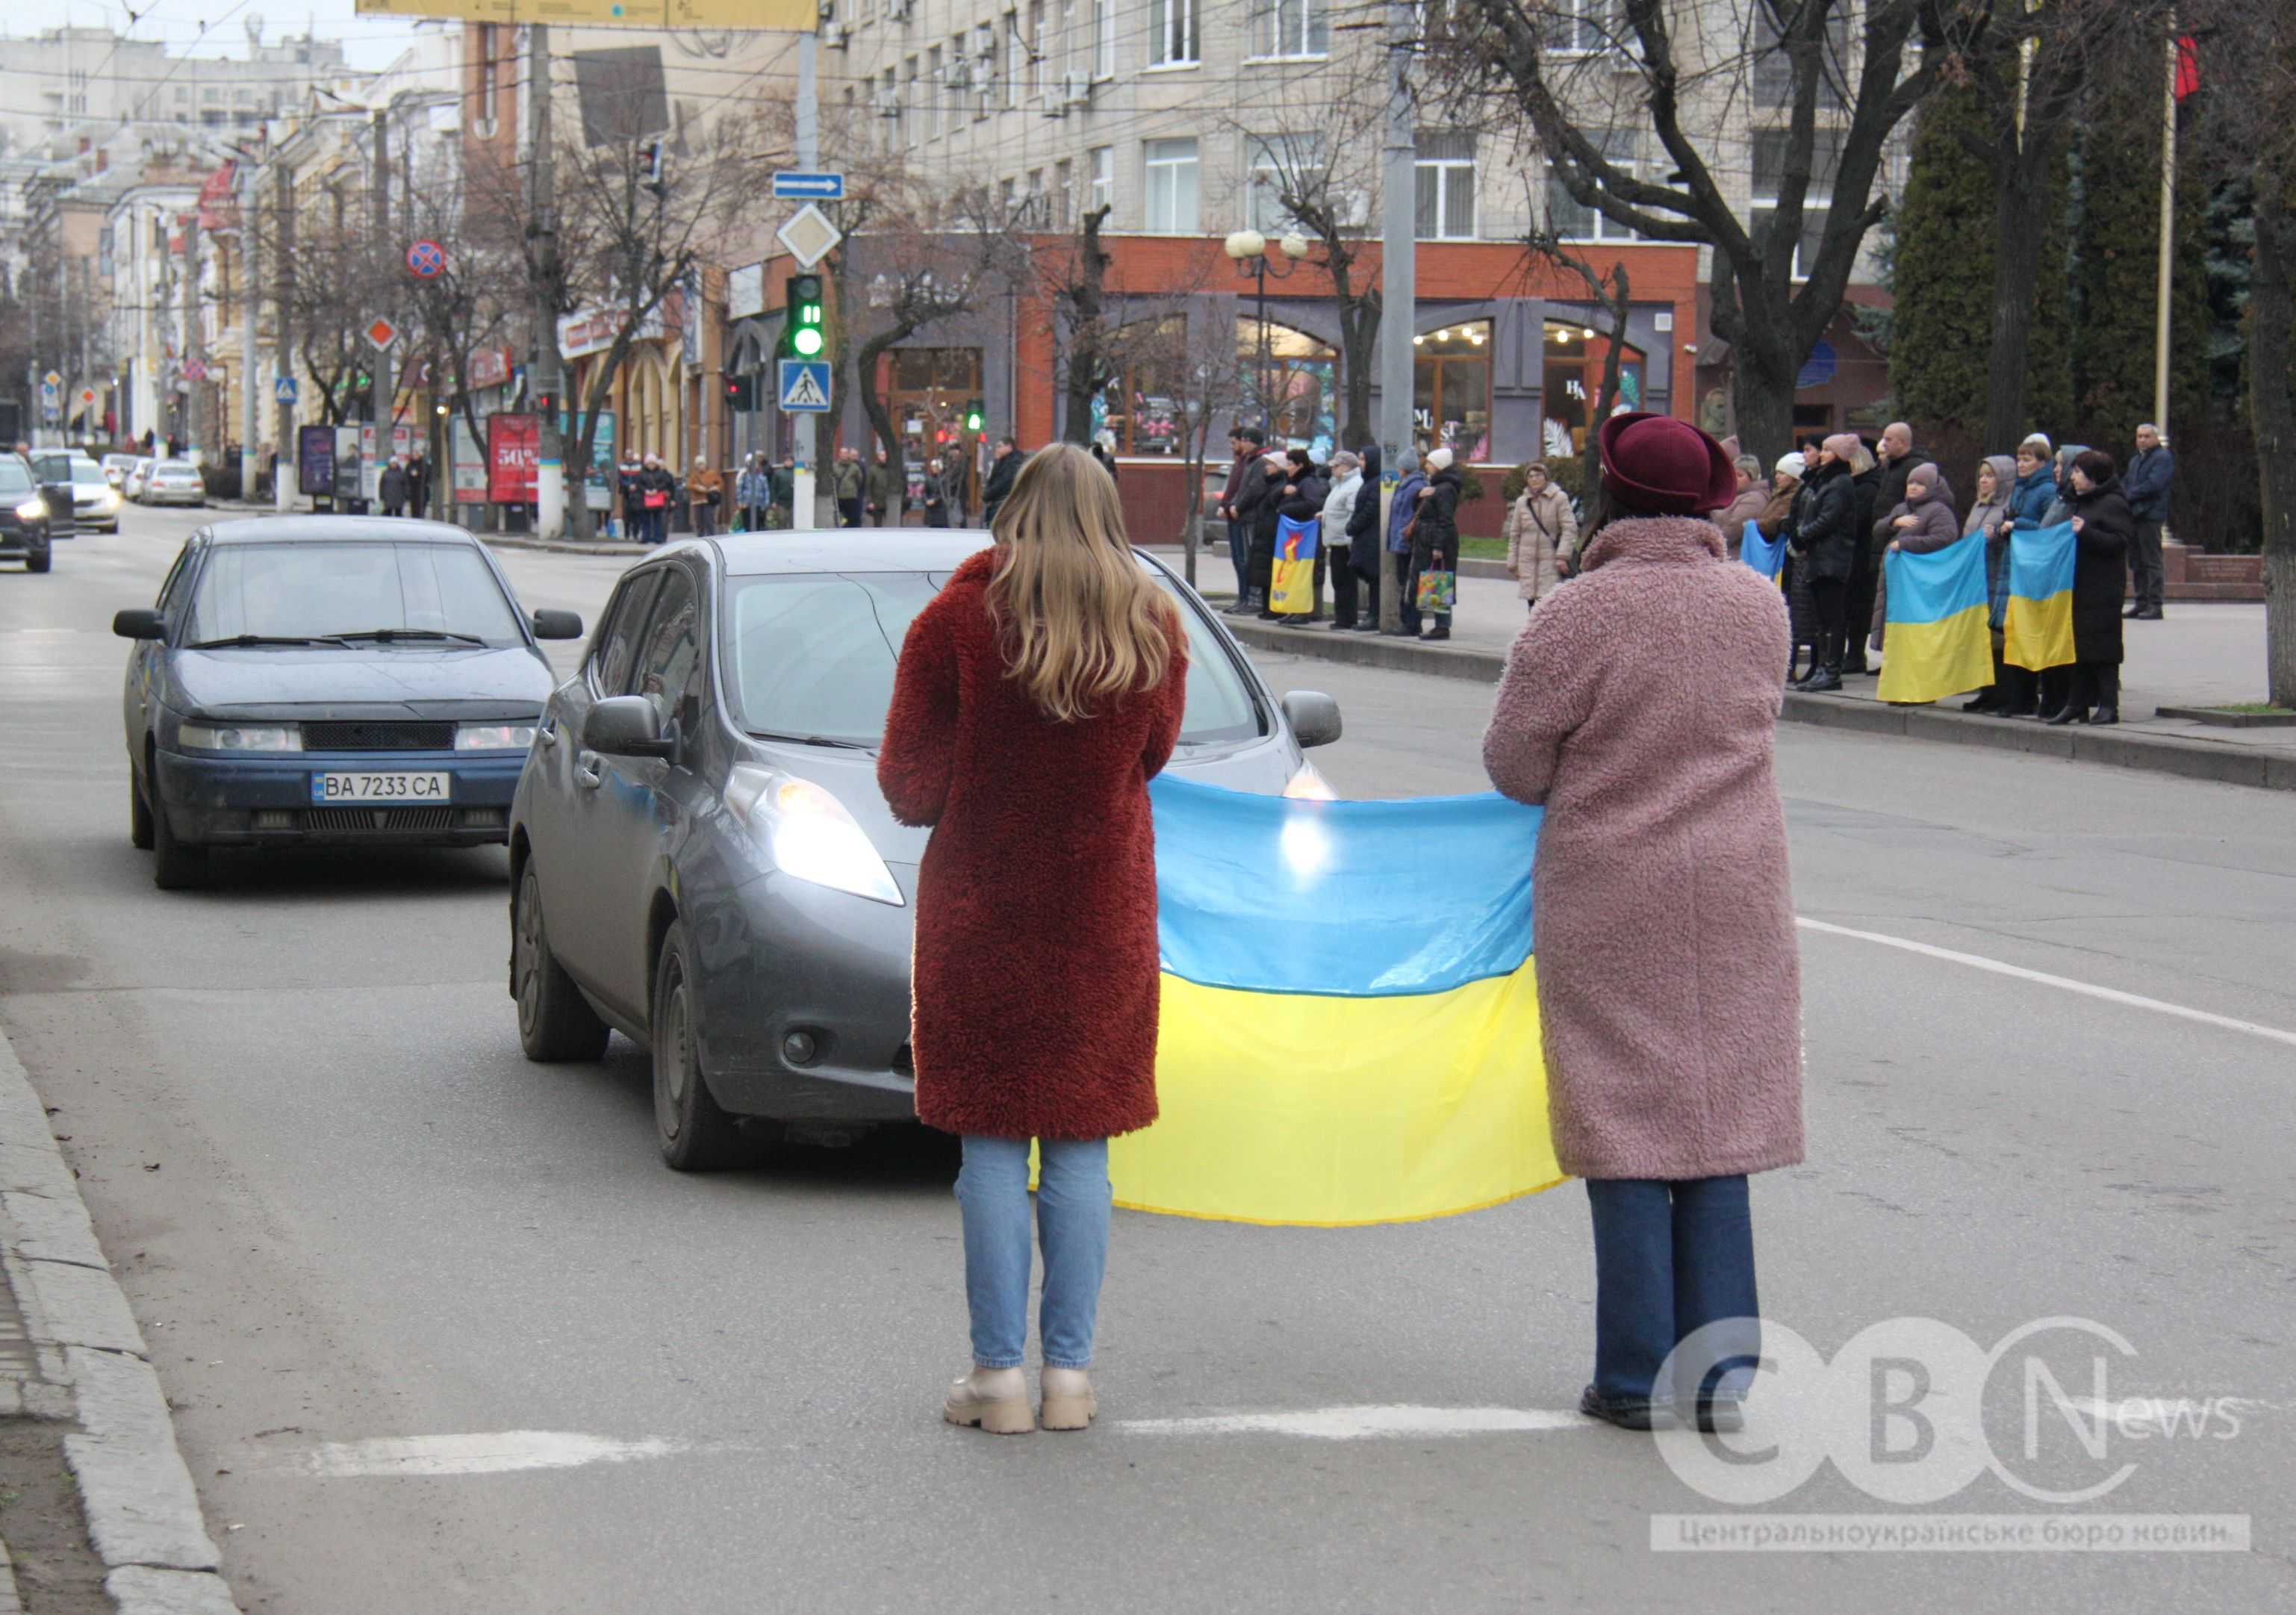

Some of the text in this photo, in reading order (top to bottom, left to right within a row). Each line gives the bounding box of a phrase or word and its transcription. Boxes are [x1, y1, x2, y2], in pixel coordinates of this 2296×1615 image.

[326, 776, 441, 797] BA 7233 CA
